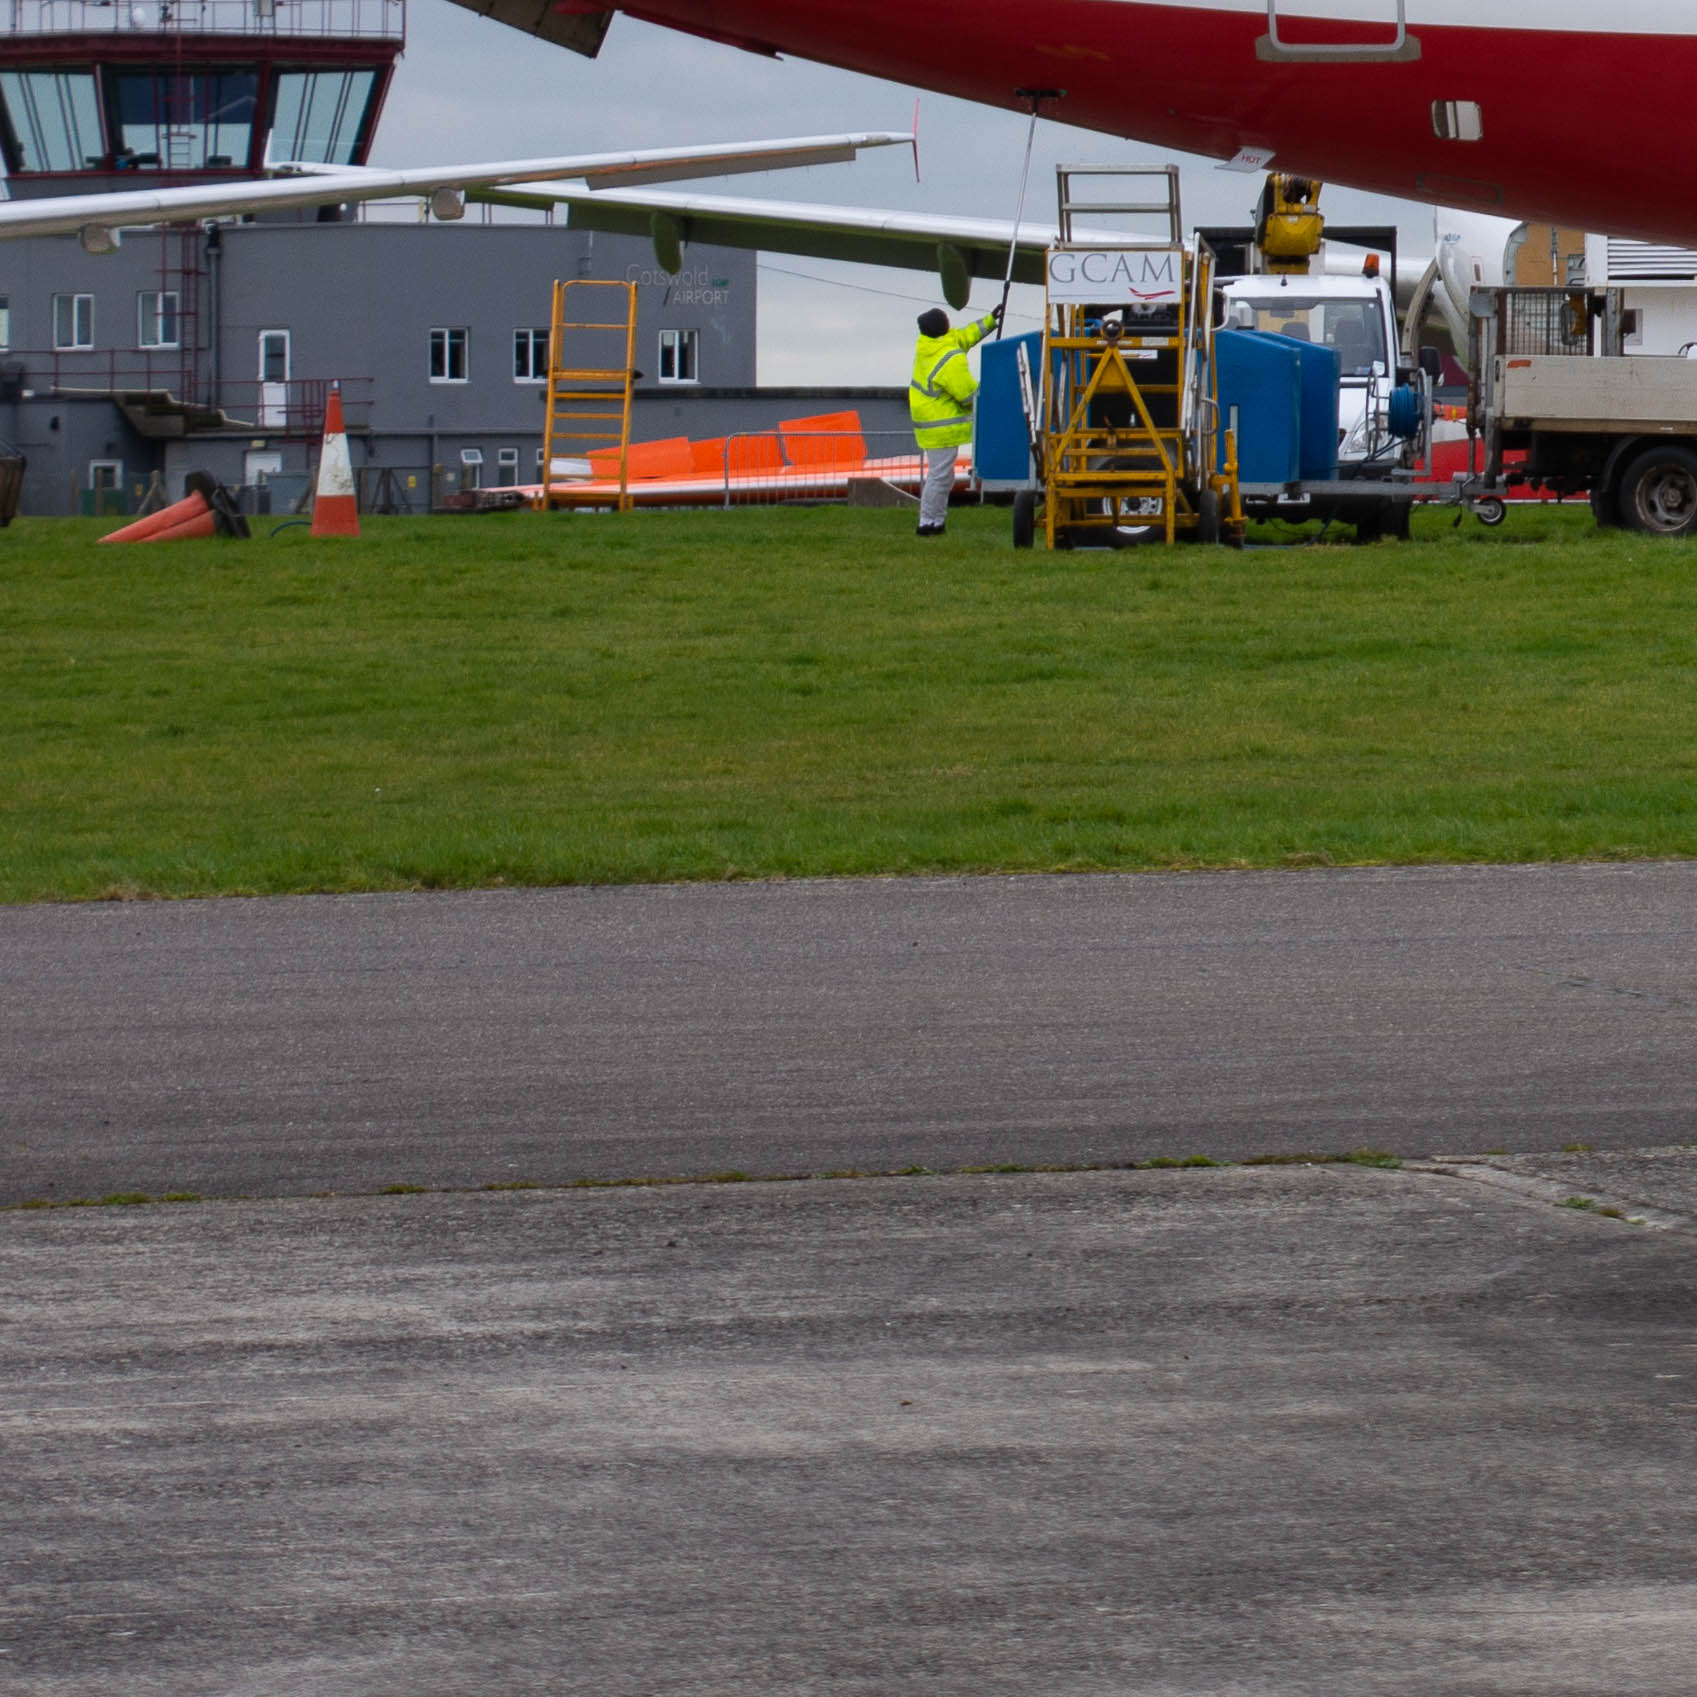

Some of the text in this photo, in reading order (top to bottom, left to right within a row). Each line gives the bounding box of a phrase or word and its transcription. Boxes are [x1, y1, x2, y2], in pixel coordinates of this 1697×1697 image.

[626, 264, 709, 285] Cotswold
[1049, 253, 1174, 283] GCAM
[672, 290, 729, 304] AIRPORT
